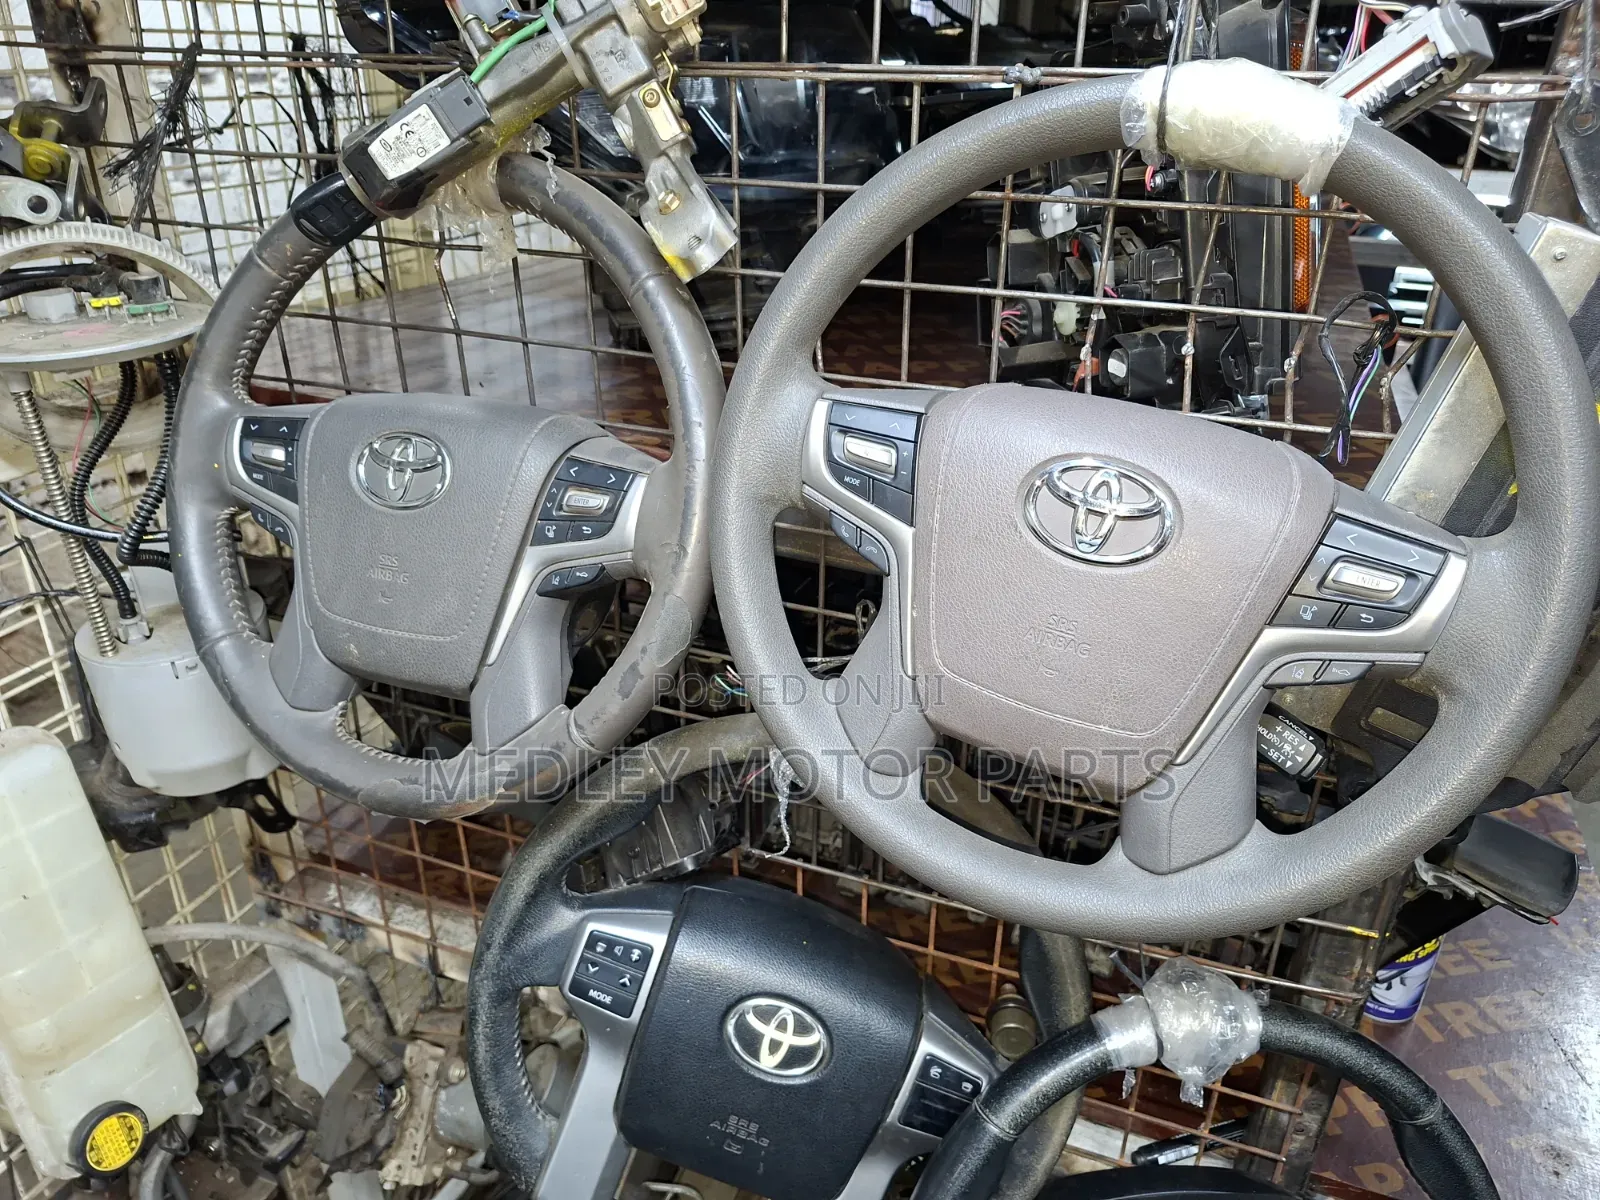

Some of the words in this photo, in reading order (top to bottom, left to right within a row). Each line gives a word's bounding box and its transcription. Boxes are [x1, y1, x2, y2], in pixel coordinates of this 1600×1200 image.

[843, 475, 861, 487] MODE
[1355, 575, 1381, 589] ENTER
[1023, 626, 1092, 659] AIRBAG
[1257, 724, 1273, 740] HOLD
[1278, 715, 1308, 739] CANCEL
[1282, 730, 1300, 746] RES
[1267, 748, 1286, 763] SET
[588, 988, 613, 1004] MODE
[729, 1114, 760, 1132] SRS
[709, 1120, 770, 1147] AIRBAG
